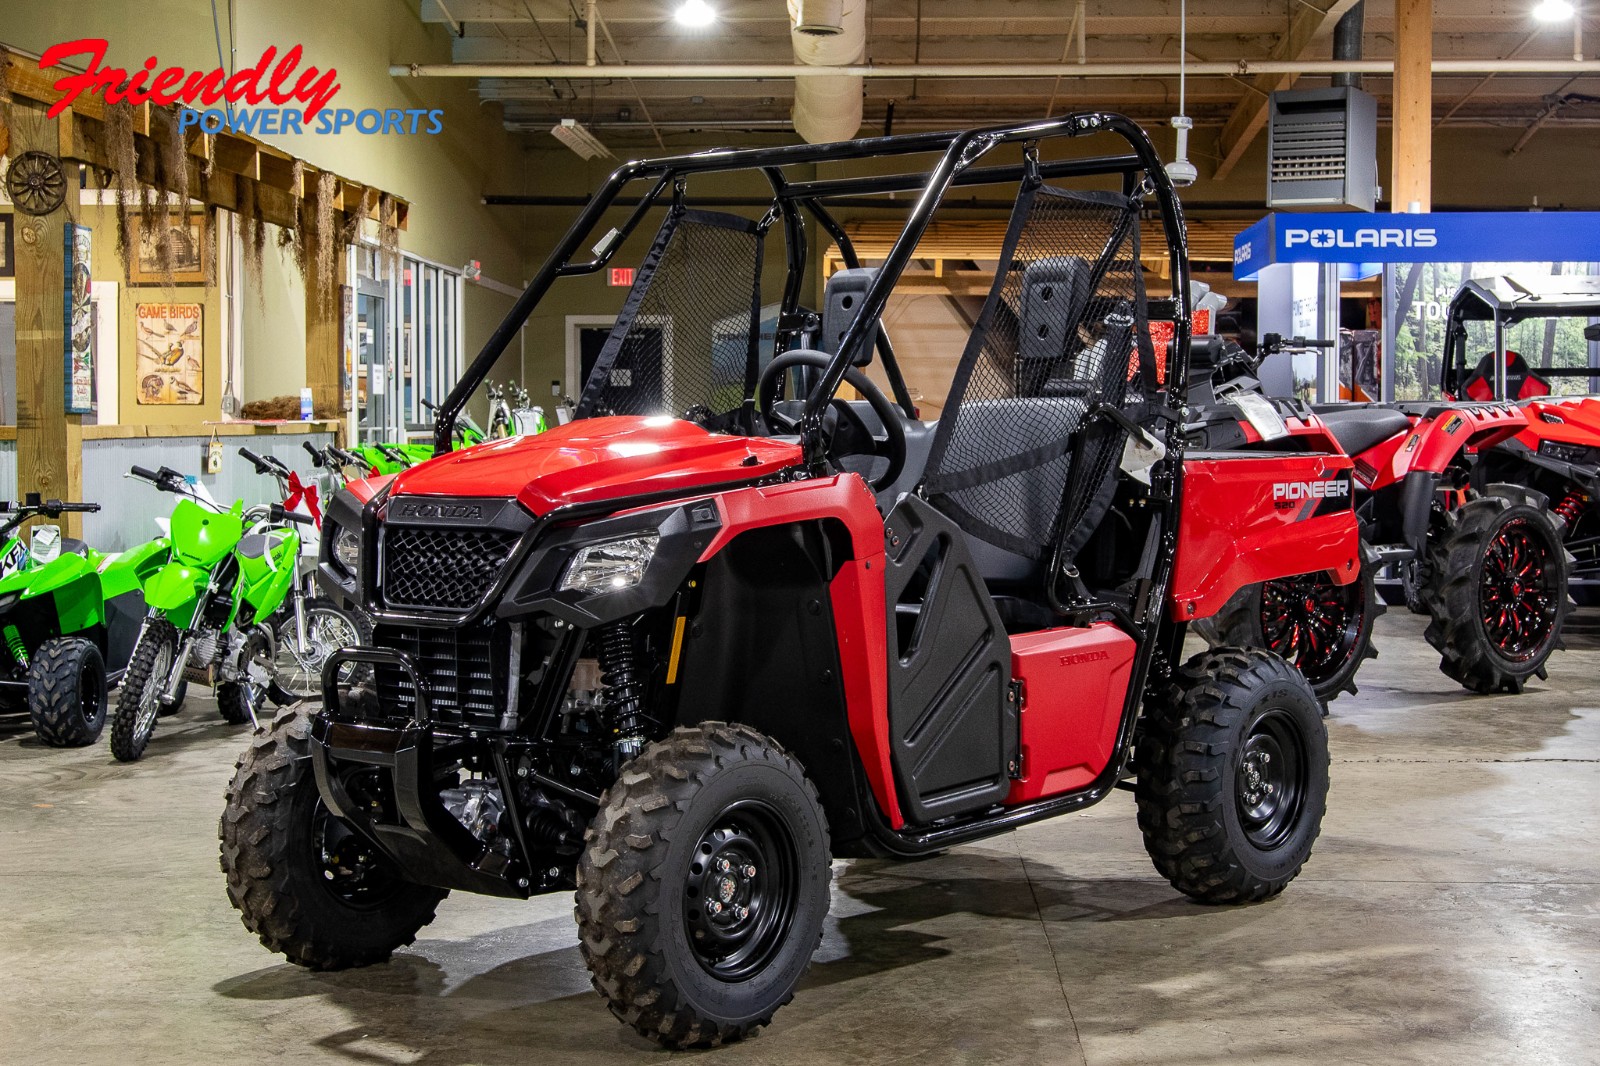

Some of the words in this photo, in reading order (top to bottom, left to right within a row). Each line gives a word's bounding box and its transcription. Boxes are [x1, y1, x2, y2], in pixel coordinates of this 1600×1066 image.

[1285, 228, 1438, 249] POLARIS
[611, 268, 634, 287] EXIT
[139, 305, 167, 318] GAME
[169, 305, 200, 318] BIRDS
[1273, 479, 1349, 500] PIONEER
[397, 503, 484, 519] HONDA
[1274, 501, 1295, 509] 520
[1060, 651, 1109, 666] HONDA
